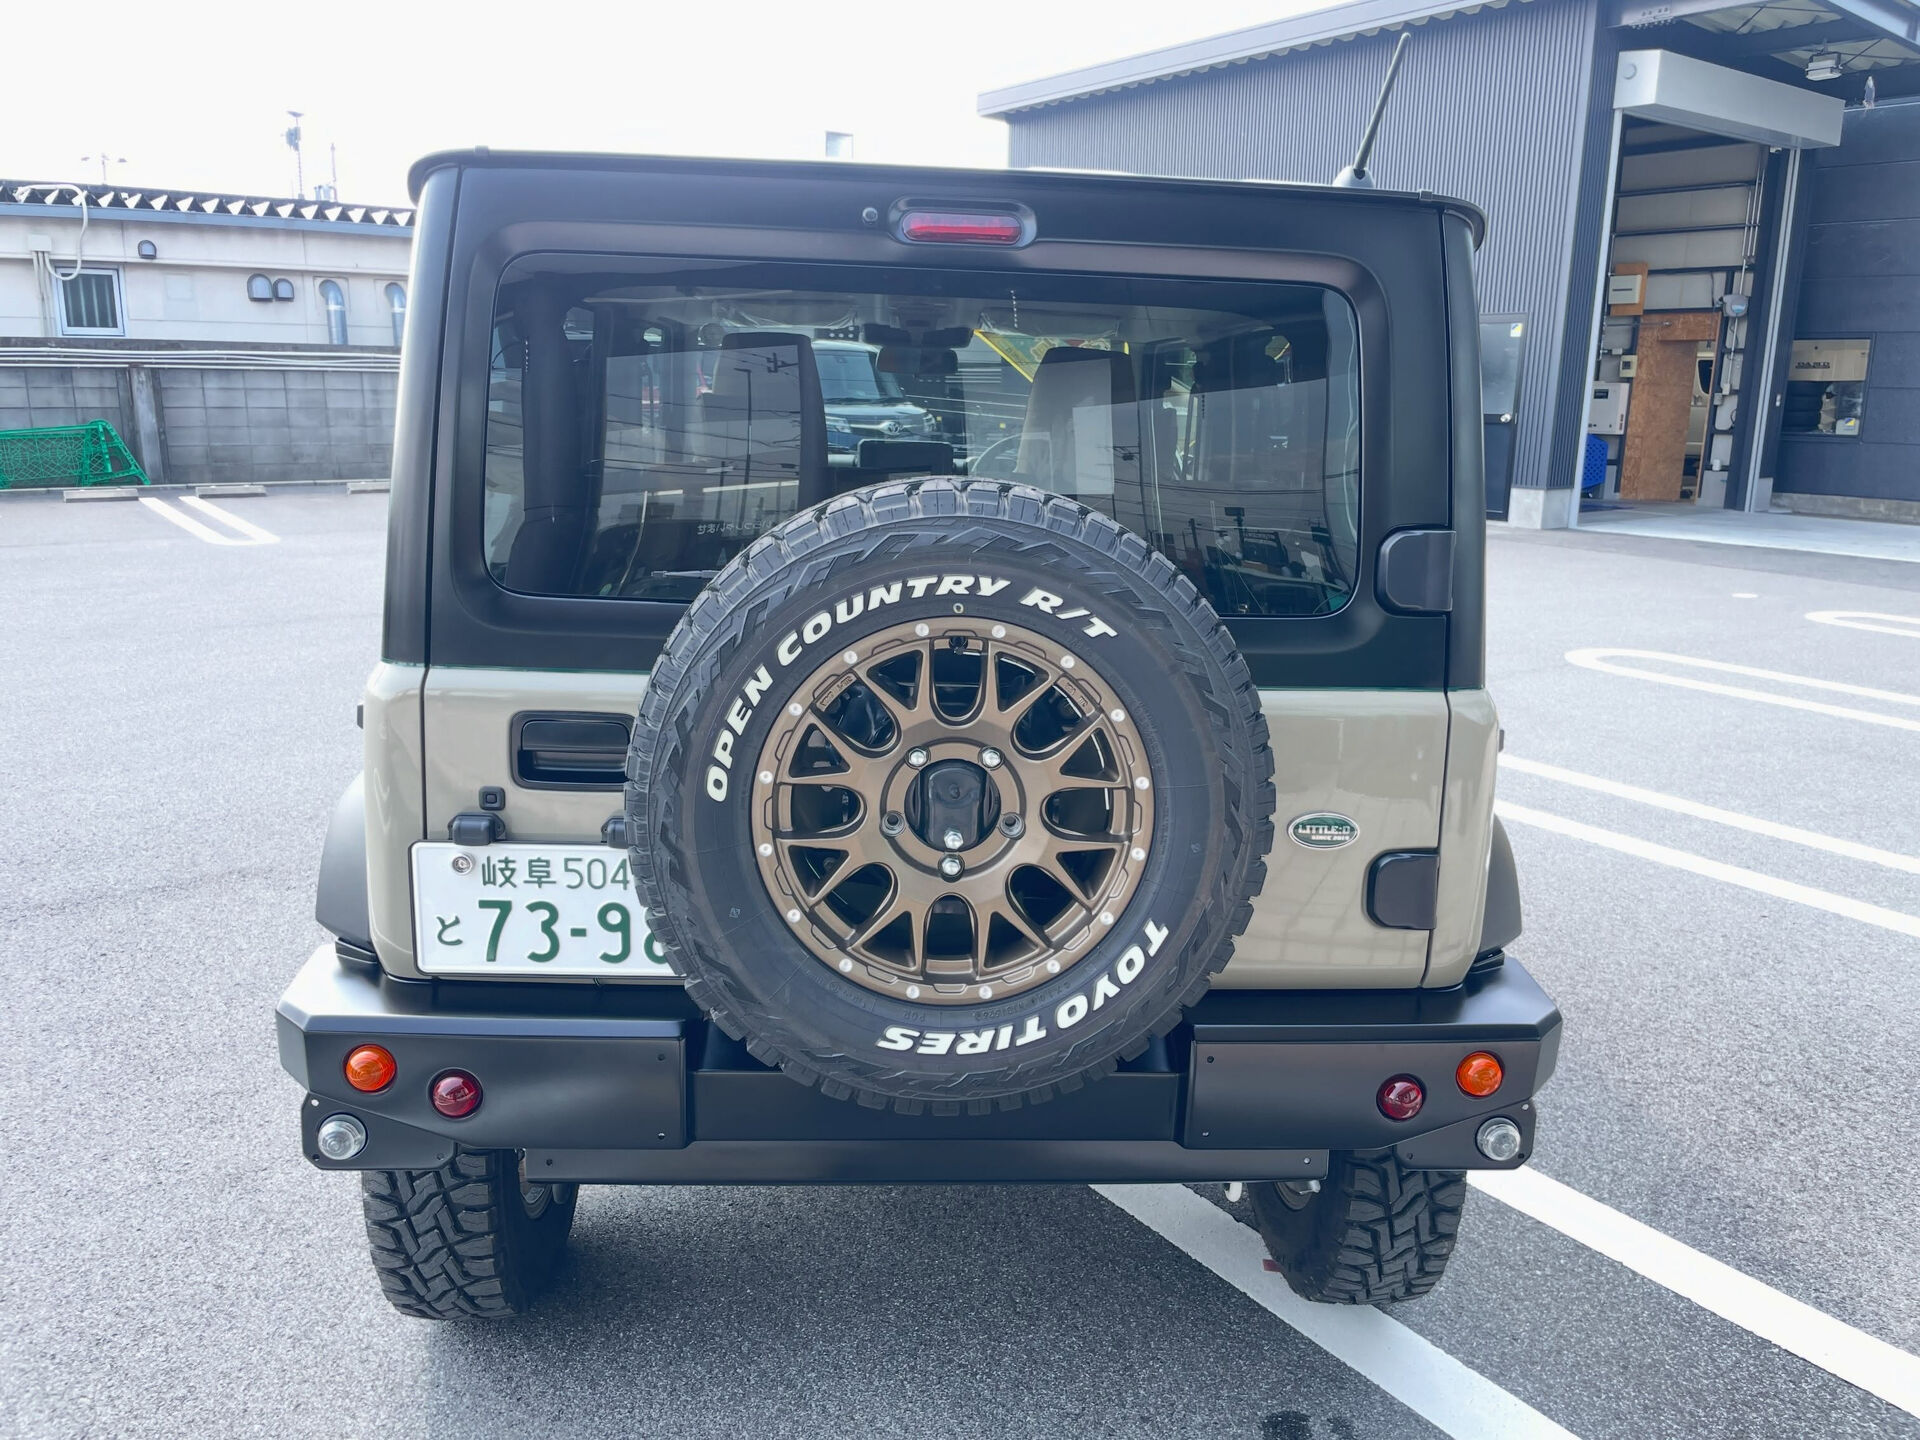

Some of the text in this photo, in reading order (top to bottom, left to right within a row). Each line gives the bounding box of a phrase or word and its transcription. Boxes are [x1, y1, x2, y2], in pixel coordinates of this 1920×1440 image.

[706, 665, 775, 802] OPEN
[776, 574, 1011, 667] COUNTRY
[1019, 586, 1118, 642] R/T
[436, 915, 463, 946] と
[1055, 917, 1169, 1030] TOYO
[876, 1015, 1047, 1055] TIRES
